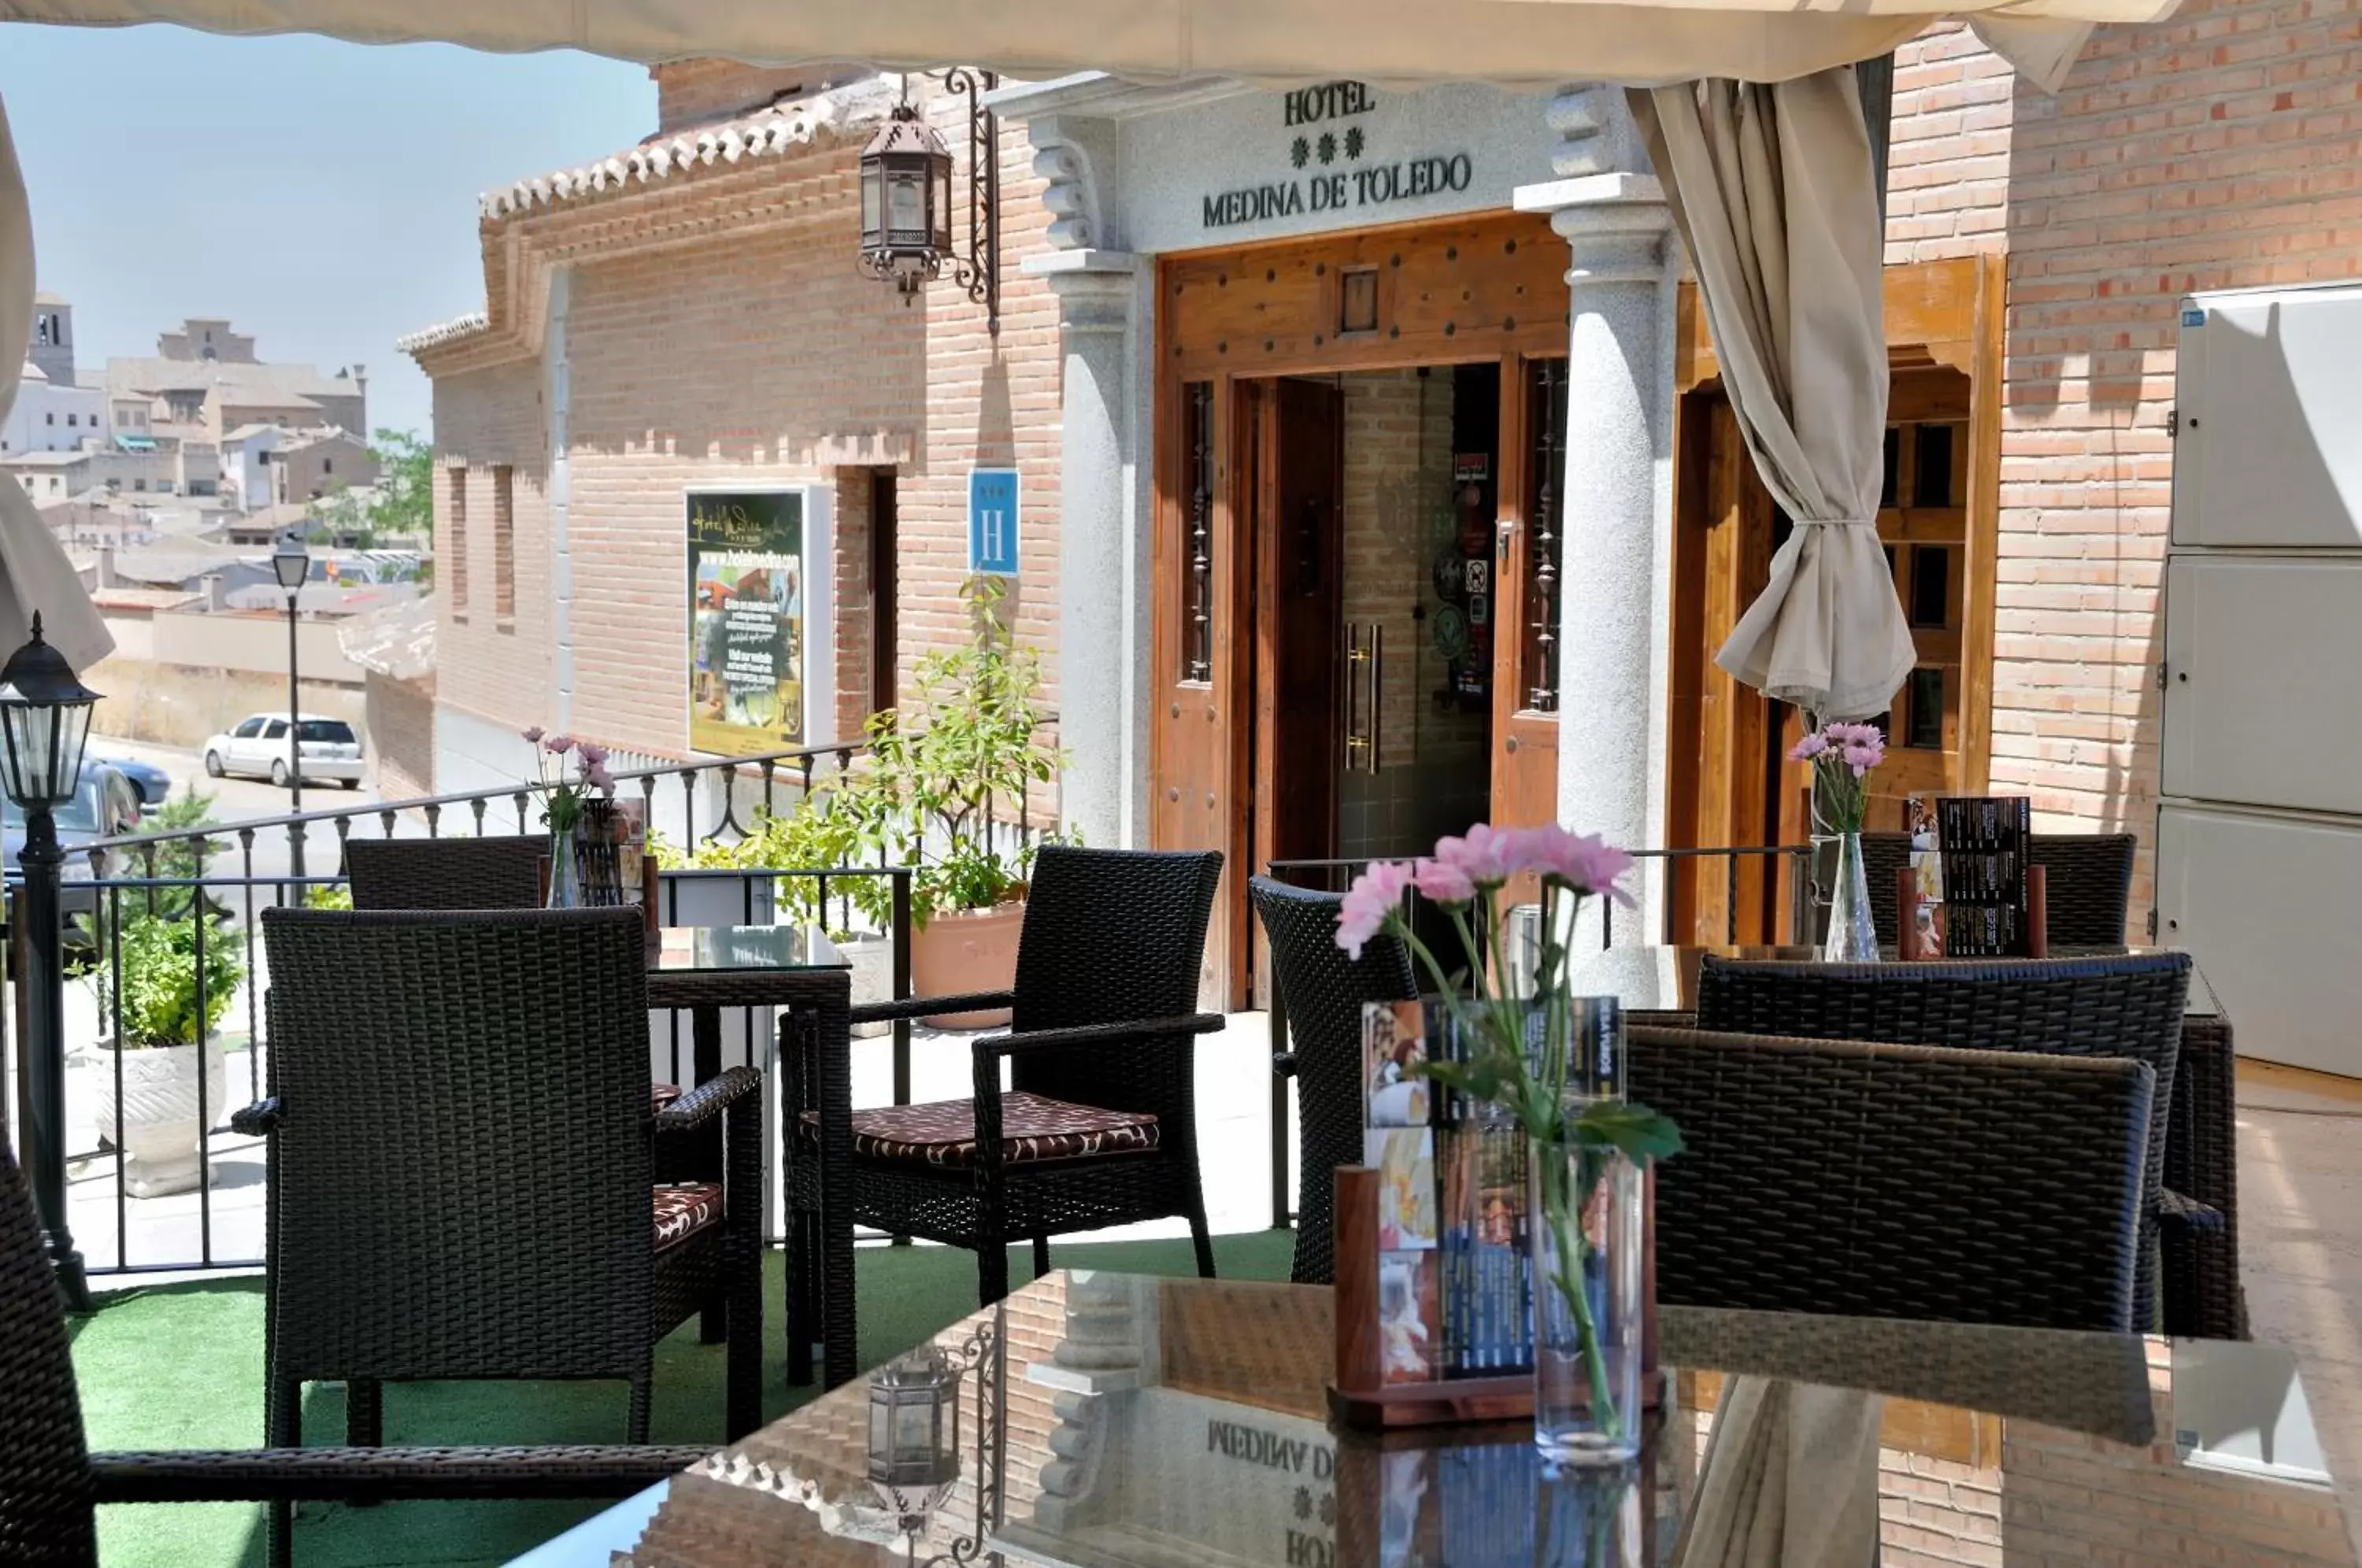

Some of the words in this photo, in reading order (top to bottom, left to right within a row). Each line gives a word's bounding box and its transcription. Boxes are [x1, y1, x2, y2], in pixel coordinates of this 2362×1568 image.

[1284, 80, 1375, 126] HOTEL
[1203, 179, 1305, 227] MEDINA
[1309, 174, 1347, 212] DE
[1352, 153, 1472, 205] TOLEDO
[979, 508, 1005, 561] H
